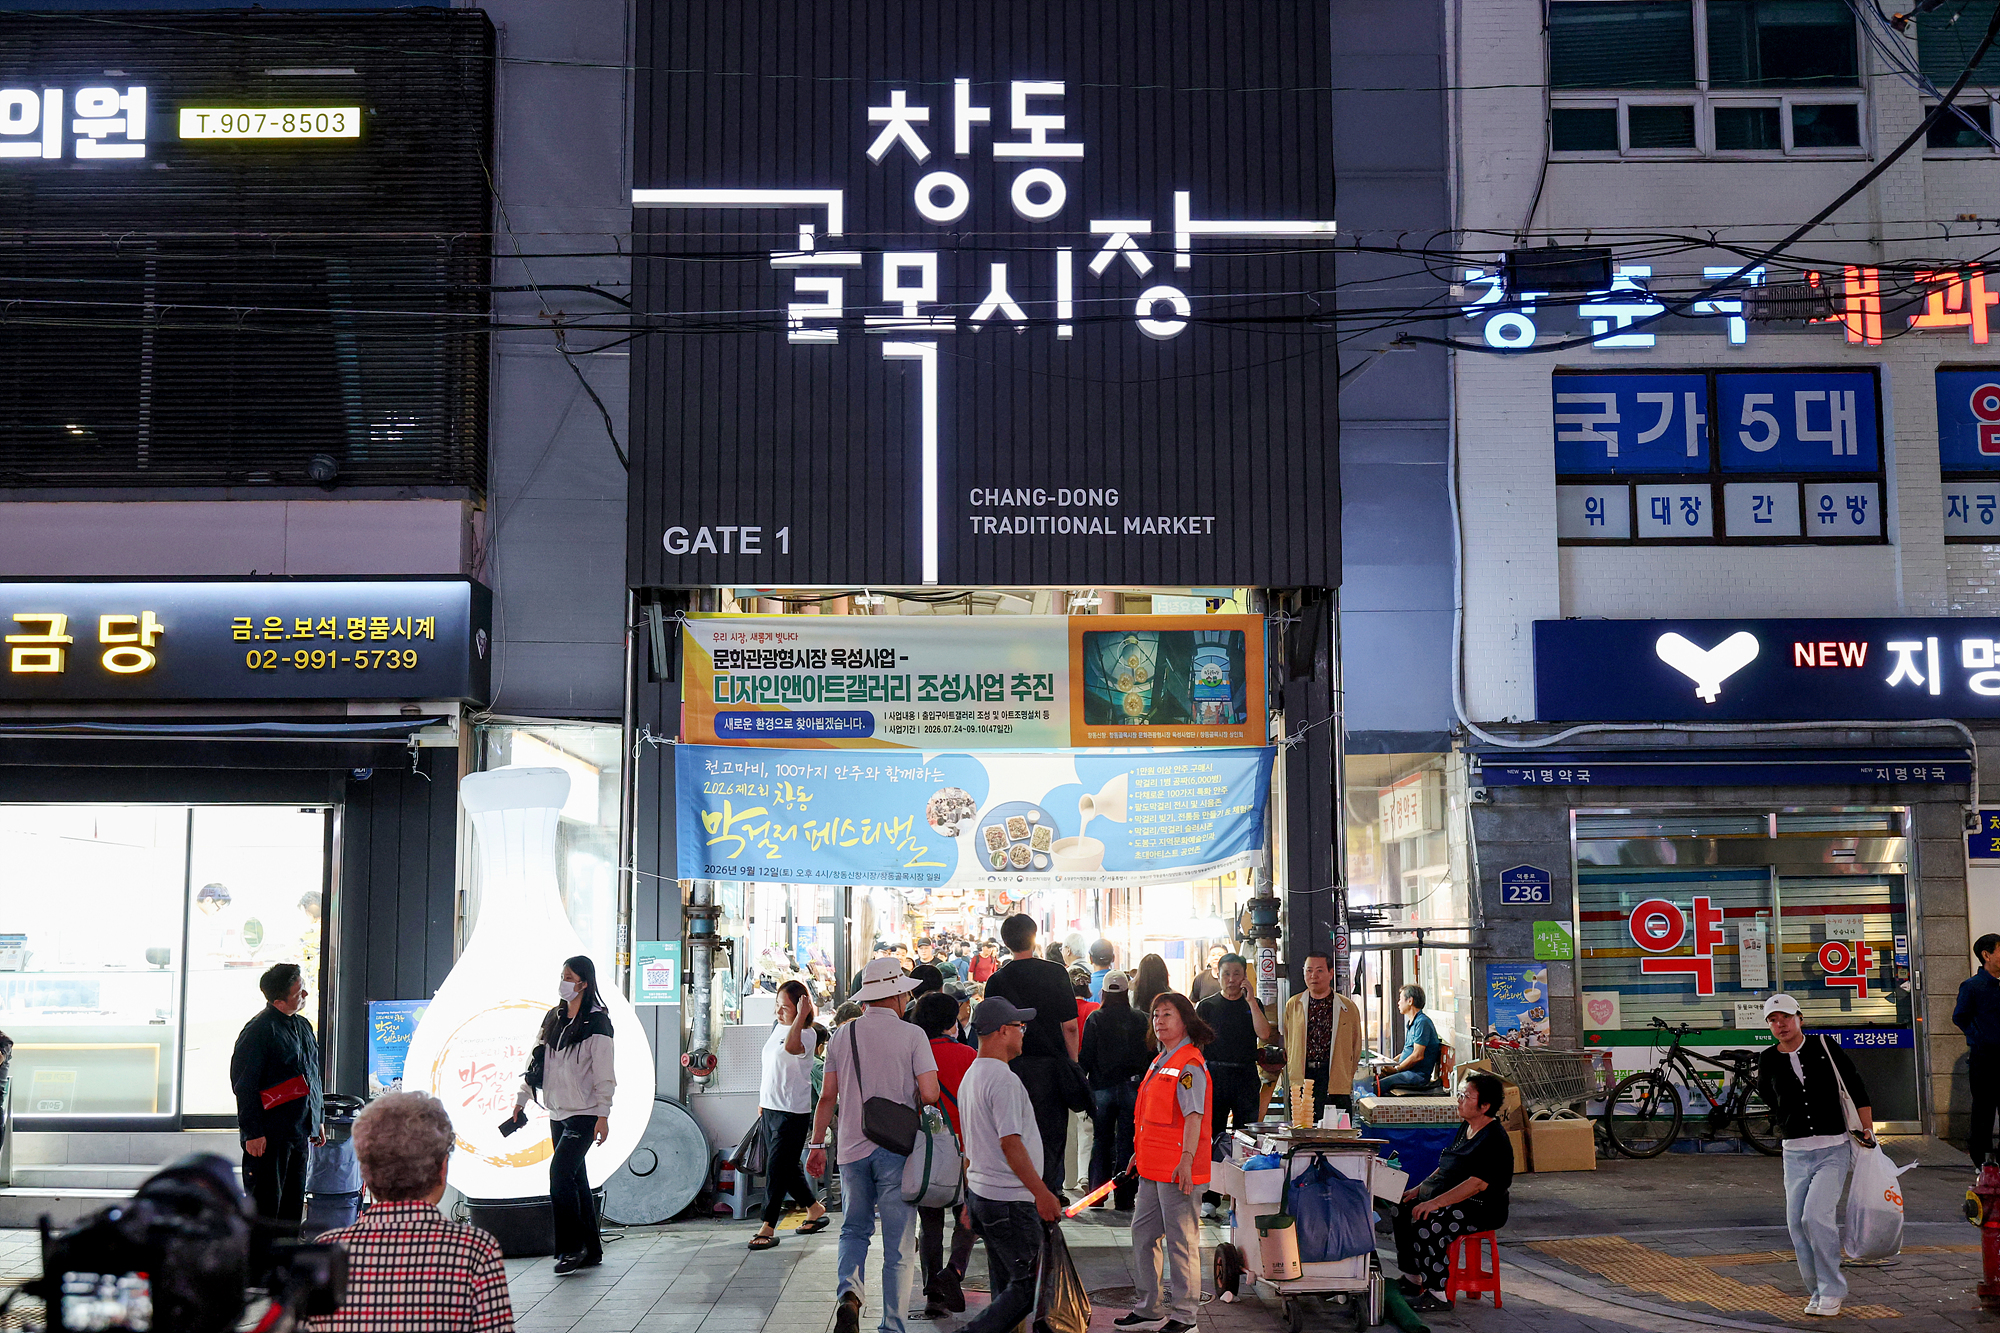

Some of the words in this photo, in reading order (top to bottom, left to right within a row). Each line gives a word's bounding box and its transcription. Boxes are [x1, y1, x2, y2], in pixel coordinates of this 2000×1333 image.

[0, 87, 147, 158] 의원
[196, 113, 346, 134] T.907-8503
[867, 78, 1085, 223] 창동
[1555, 391, 1707, 458] 국가
[1737, 390, 1858, 456] 5대
[970, 488, 1119, 507] CHANG-DONG
[1585, 496, 1606, 526] 위
[1651, 495, 1701, 527] 대장
[1752, 495, 1774, 524] 간
[1817, 494, 1868, 525] 유방
[1947, 495, 1997, 525] 자궁
[970, 516, 1116, 535] TRADITIONAL
[1123, 516, 1215, 535] MARKET
[663, 526, 762, 555] GATE
[775, 526, 790, 555] 1
[231, 616, 436, 642] 금.은.보석.명품시계
[713, 632, 727, 643] 우리
[730, 632, 748, 644] 시장,
[750, 632, 773, 644] 새롭게
[775, 632, 799, 644] 빛나다
[5, 610, 165, 675] 금당
[246, 649, 419, 670] 02-991-5739
[713, 648, 827, 669] 문화관광형시장
[831, 648, 895, 669] 육성사업
[1794, 641, 1868, 667] NEW
[714, 674, 912, 703] 디자인앤아트갤러리
[917, 673, 1005, 702] 조성사업
[1010, 673, 1054, 702] 추진
[724, 717, 752, 731] 새로운
[755, 717, 794, 731] 환경으로
[796, 717, 866, 731] 찾아뵙겠습니다.
[888, 711, 916, 720] 사업내용
[922, 710, 975, 720] 출입구아트갤러리
[977, 711, 990, 720] 조성
[992, 711, 999, 720] 및
[1001, 710, 1041, 720] 아트조명설치
[1043, 710, 1050, 720] 등
[888, 724, 916, 734] 사업기간
[705, 759, 768, 778] 천고마비,
[775, 764, 828, 780] 100가지
[834, 766, 880, 782] 안주와
[885, 766, 945, 783] 함께하는
[1136, 767, 1155, 775] 1만원
[1157, 766, 1172, 774] 이상
[1174, 764, 1188, 773] 안주
[1522, 768, 1591, 783] 지명약국
[1876, 766, 1946, 782] 지명약국
[1135, 779, 1157, 788] 막걸리
[1160, 777, 1171, 786] 1병
[1135, 790, 1164, 799] 다채로운
[1167, 788, 1195, 798] 100가지
[1213, 786, 1228, 795] 안주
[773, 781, 813, 811] 창동
[1174, 801, 1188, 809] 전시
[1135, 815, 1157, 824] 막걸리
[701, 799, 797, 859] 막걸리
[803, 815, 947, 868] 페스티벌
[704, 865, 737, 875] 2026년
[740, 866, 755, 876] 9월
[759, 866, 793, 877] 12일(토)
[796, 869, 813, 878] 오후
[926, 872, 941, 881] 일원
[1509, 886, 1543, 901] 236
[1537, 932, 1561, 942] 세이프
[1629, 896, 1725, 997] 약
[1547, 942, 1571, 956] 약국
[1818, 940, 1874, 999] 약
[1853, 1033, 1899, 1045] 건강상담
[458, 1060, 513, 1108] 막걸리
